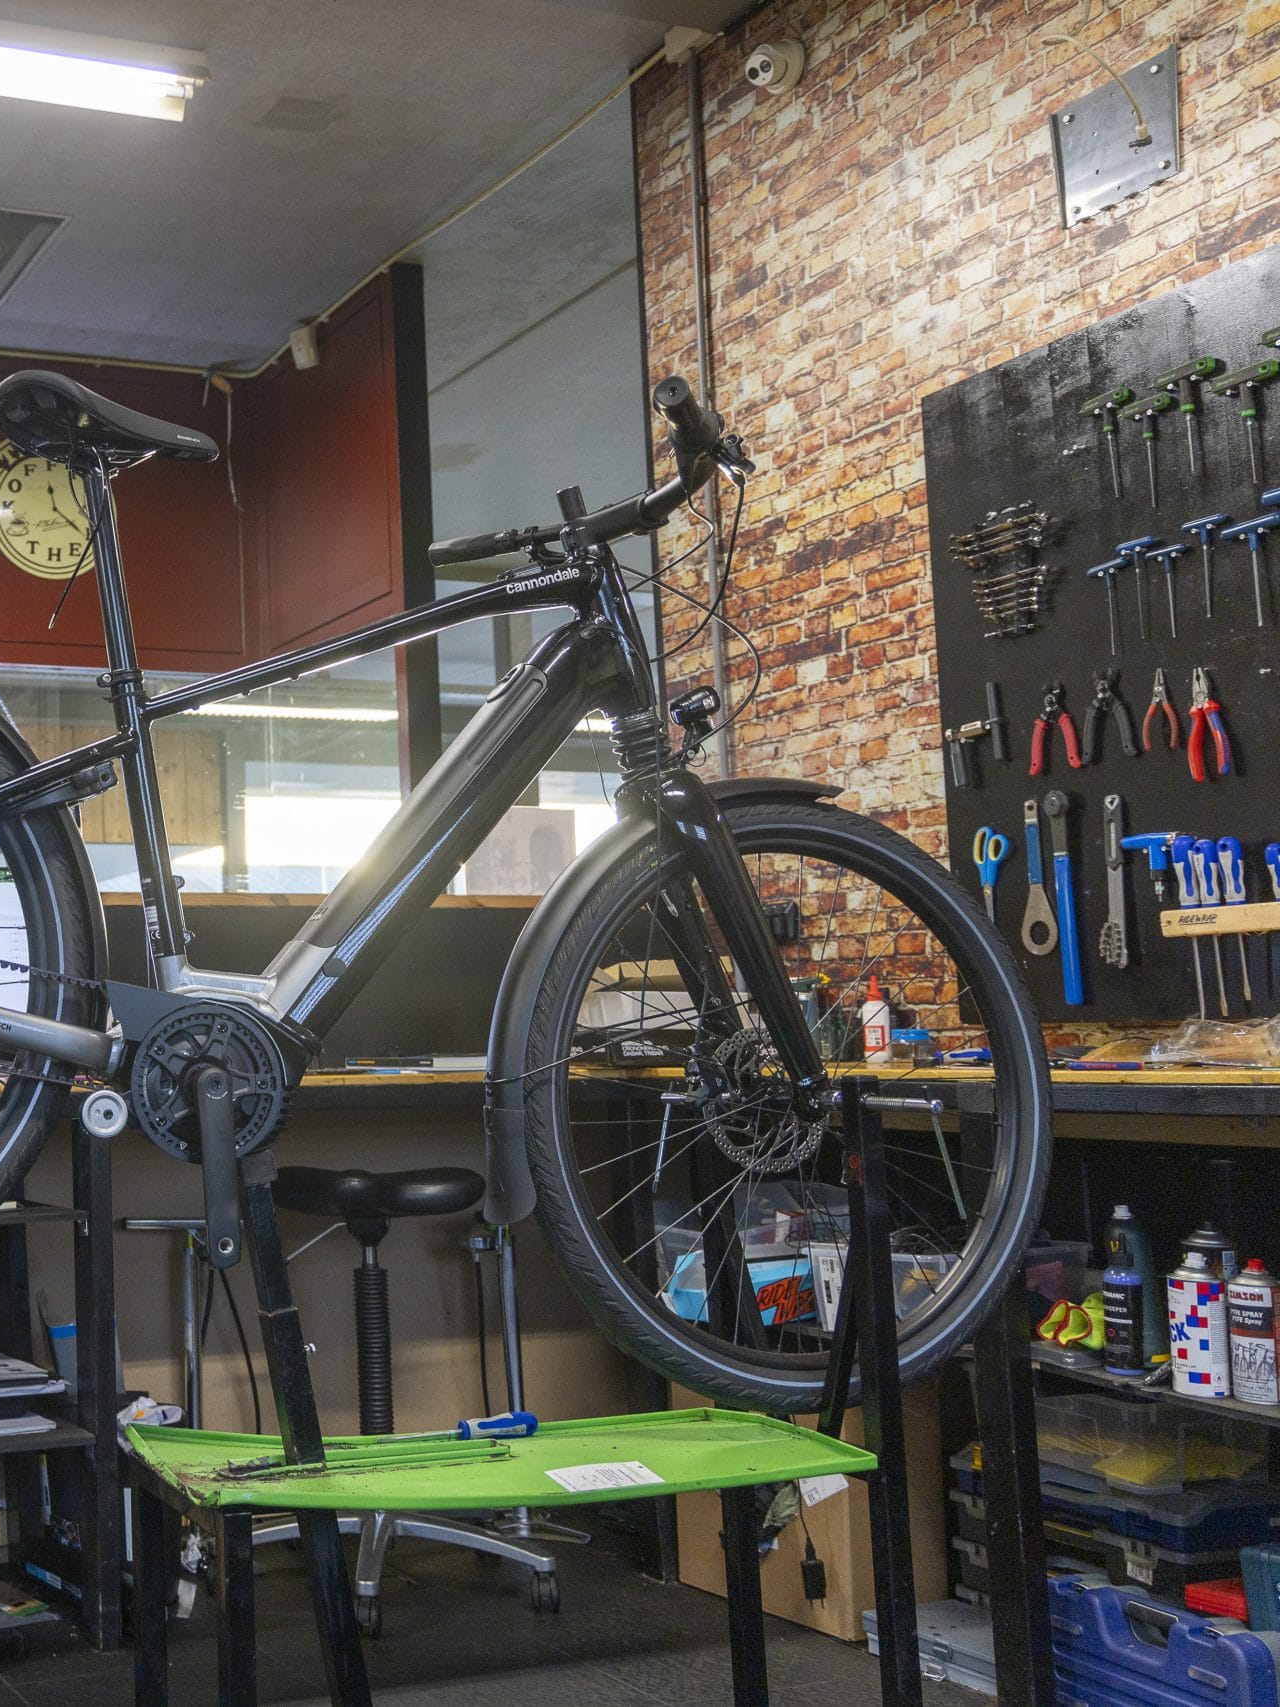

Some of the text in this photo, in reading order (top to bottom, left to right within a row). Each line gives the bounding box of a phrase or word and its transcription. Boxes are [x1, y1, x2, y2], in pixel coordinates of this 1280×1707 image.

[506, 567, 580, 594] cannondale
[1241, 1310, 1264, 1318] SPRAY
[1244, 1317, 1263, 1326] Spray
